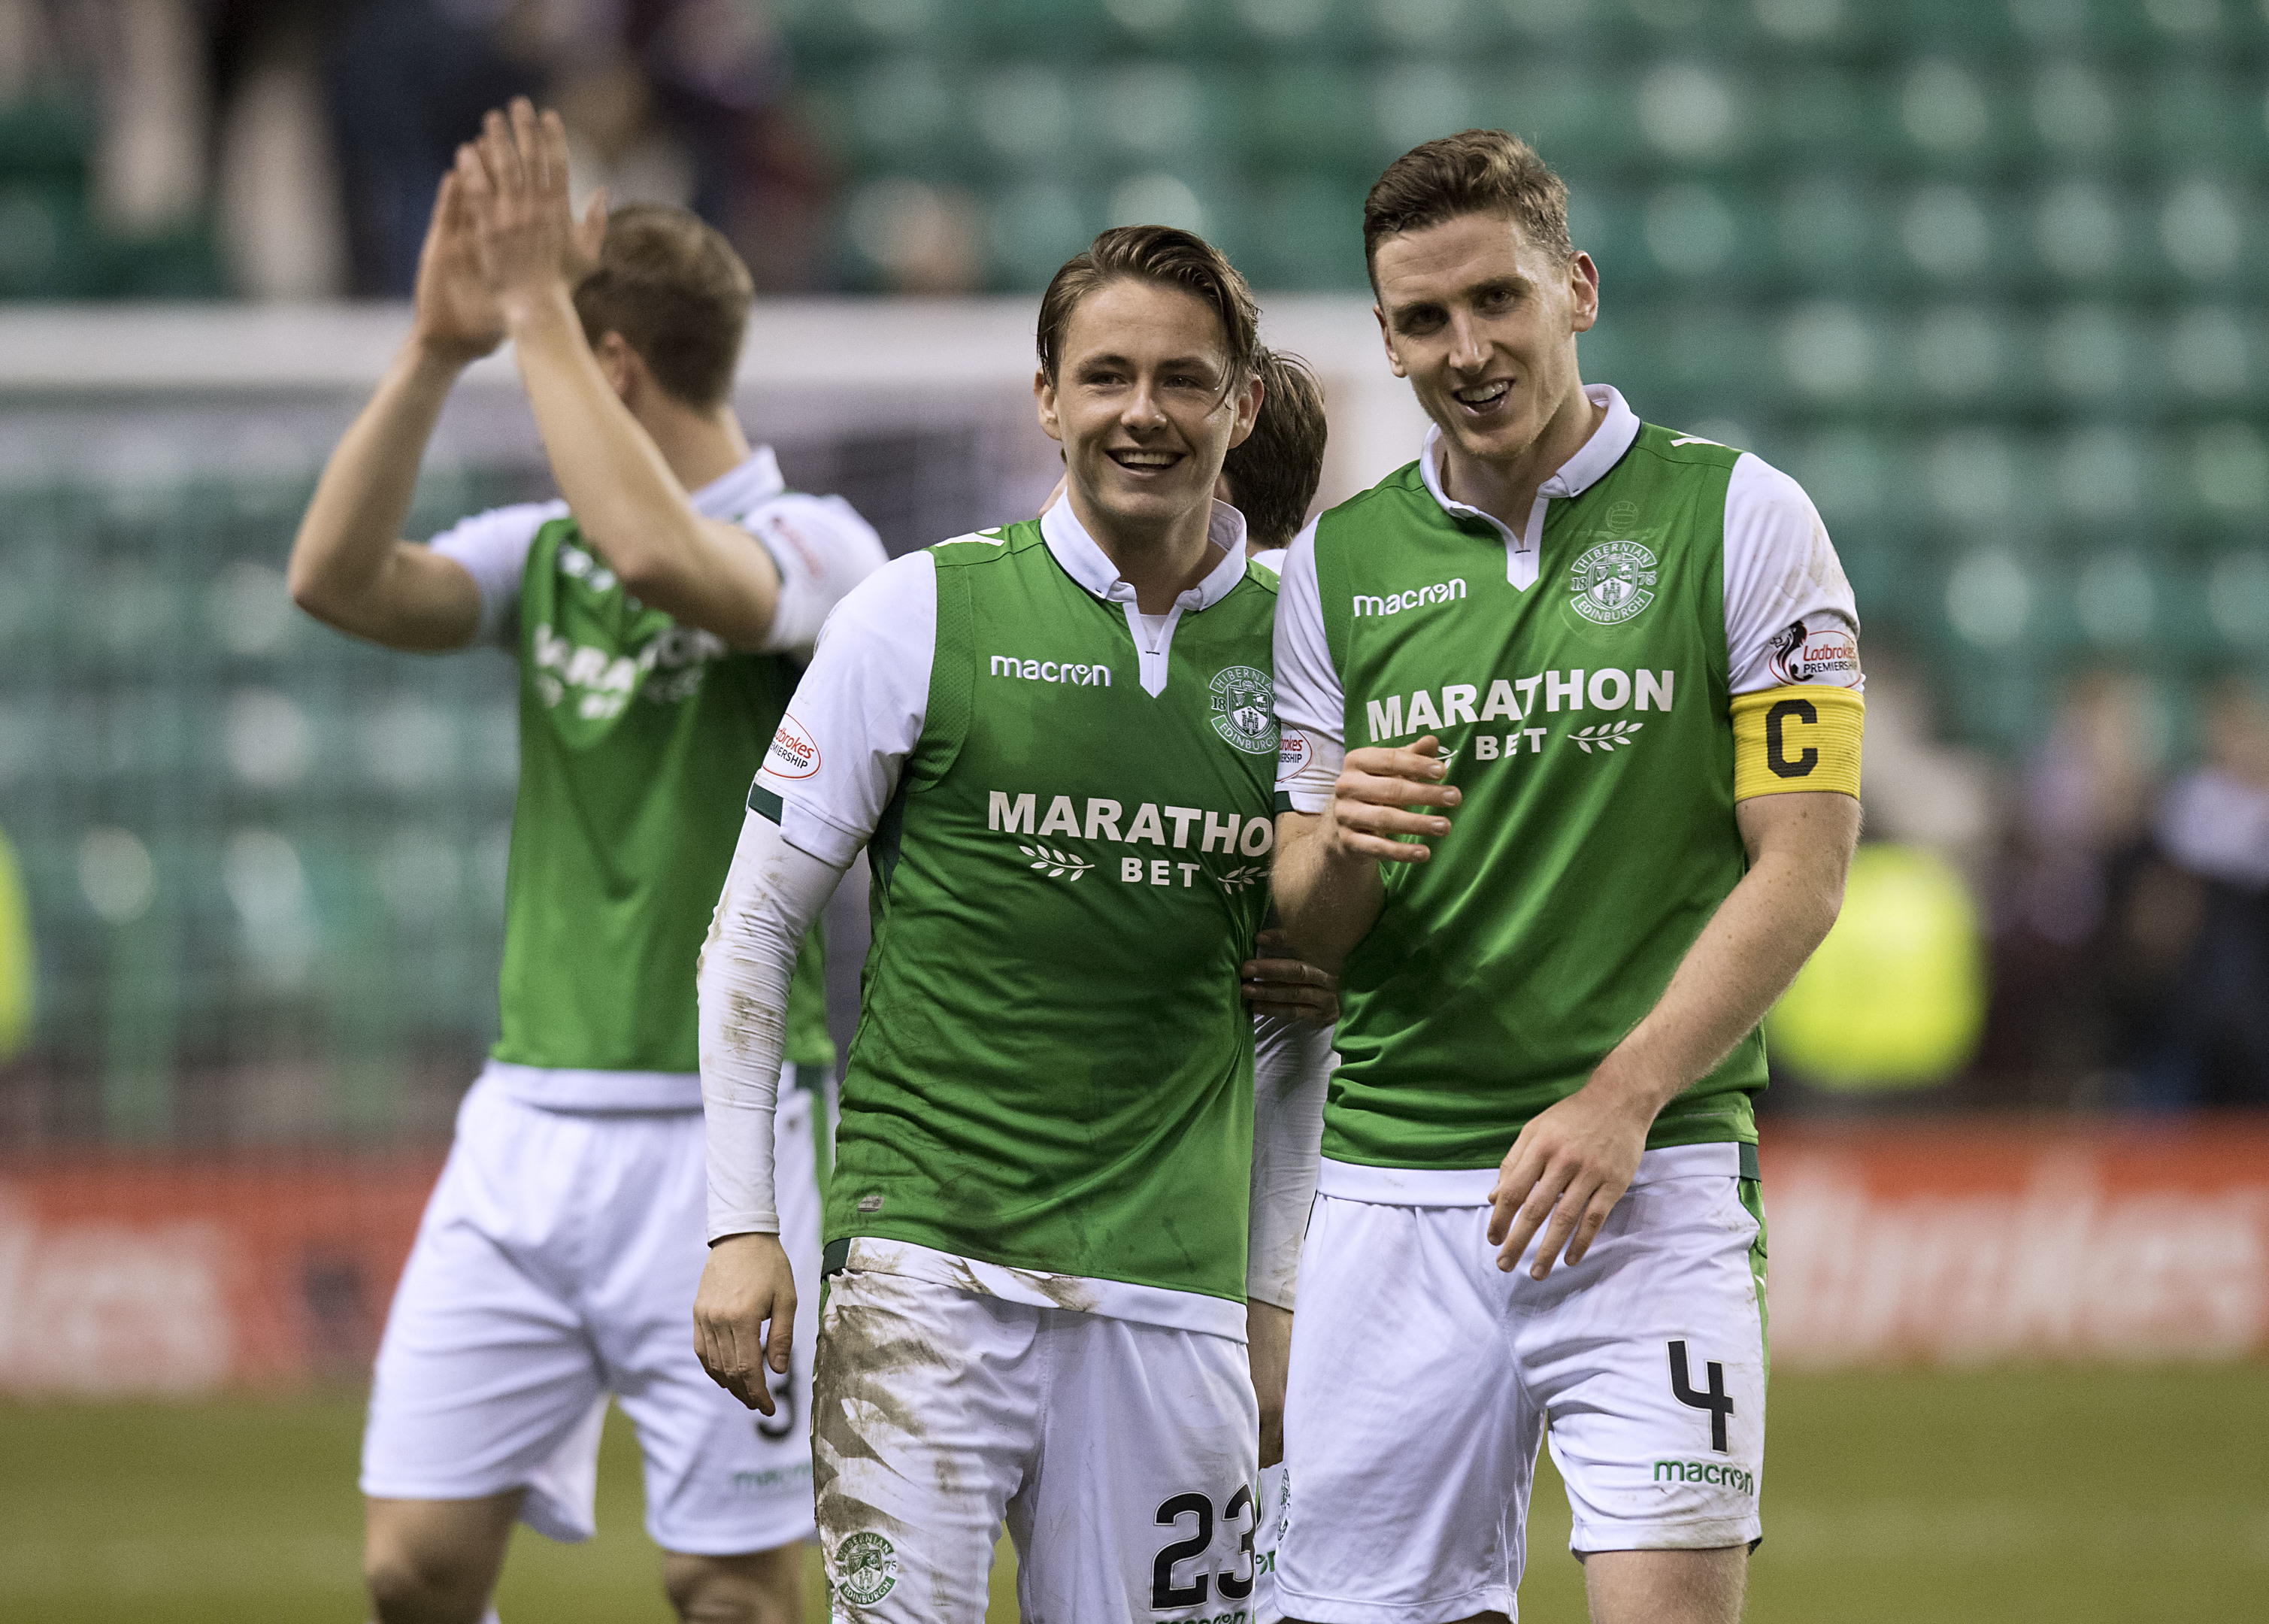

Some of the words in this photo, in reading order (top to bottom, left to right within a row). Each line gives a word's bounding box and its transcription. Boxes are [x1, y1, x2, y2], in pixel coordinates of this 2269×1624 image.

[1578, 543, 1652, 568] HIBERNIAN
[1571, 577, 1588, 591] 18
[1637, 571, 1657, 586] 75
[1353, 577, 1467, 618] macron
[1578, 595, 1646, 622] EDINBURGH
[990, 655, 1112, 687] macron
[1214, 668, 1274, 690] HIBERNIA
[1210, 695, 1227, 712] 18
[1365, 668, 1675, 743] MARATHON
[1219, 723, 1279, 750] EDINBURGH
[1474, 727, 1547, 761] BET
[1765, 698, 1819, 779] C
[988, 790, 1274, 857] MARATHO
[1121, 856, 1201, 888] BET
[1665, 1338, 1736, 1456] 4
[1653, 1460, 1755, 1496] macron
[1150, 1480, 1256, 1611] 23
[843, 1580, 892, 1604] EDINBURGH
